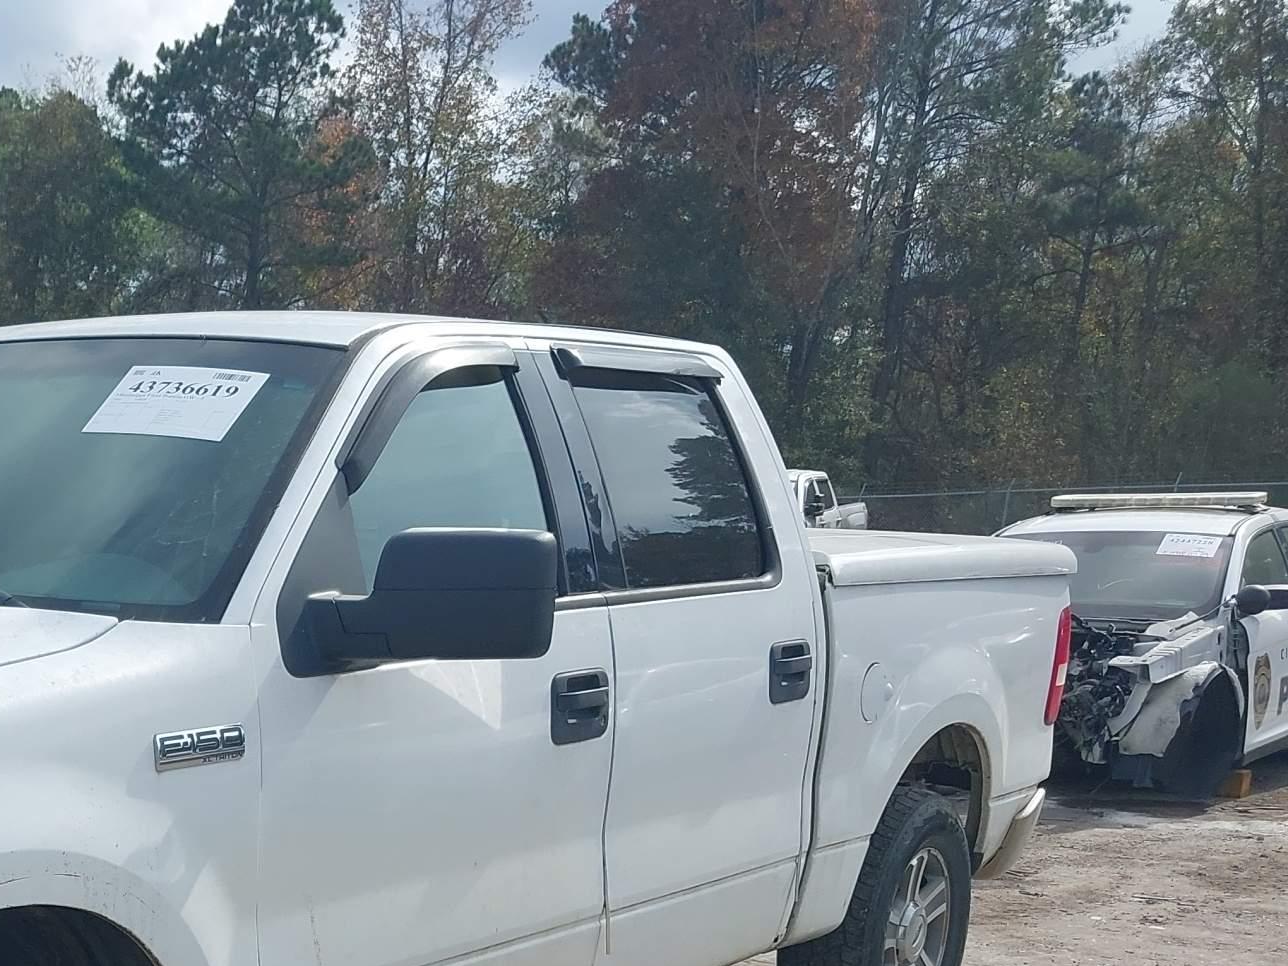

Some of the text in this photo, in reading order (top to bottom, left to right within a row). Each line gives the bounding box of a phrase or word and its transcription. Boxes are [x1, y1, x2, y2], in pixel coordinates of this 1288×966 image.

[128, 380, 239, 398] 43736619
[159, 727, 244, 760] F-150
[215, 749, 244, 761] TRITON
